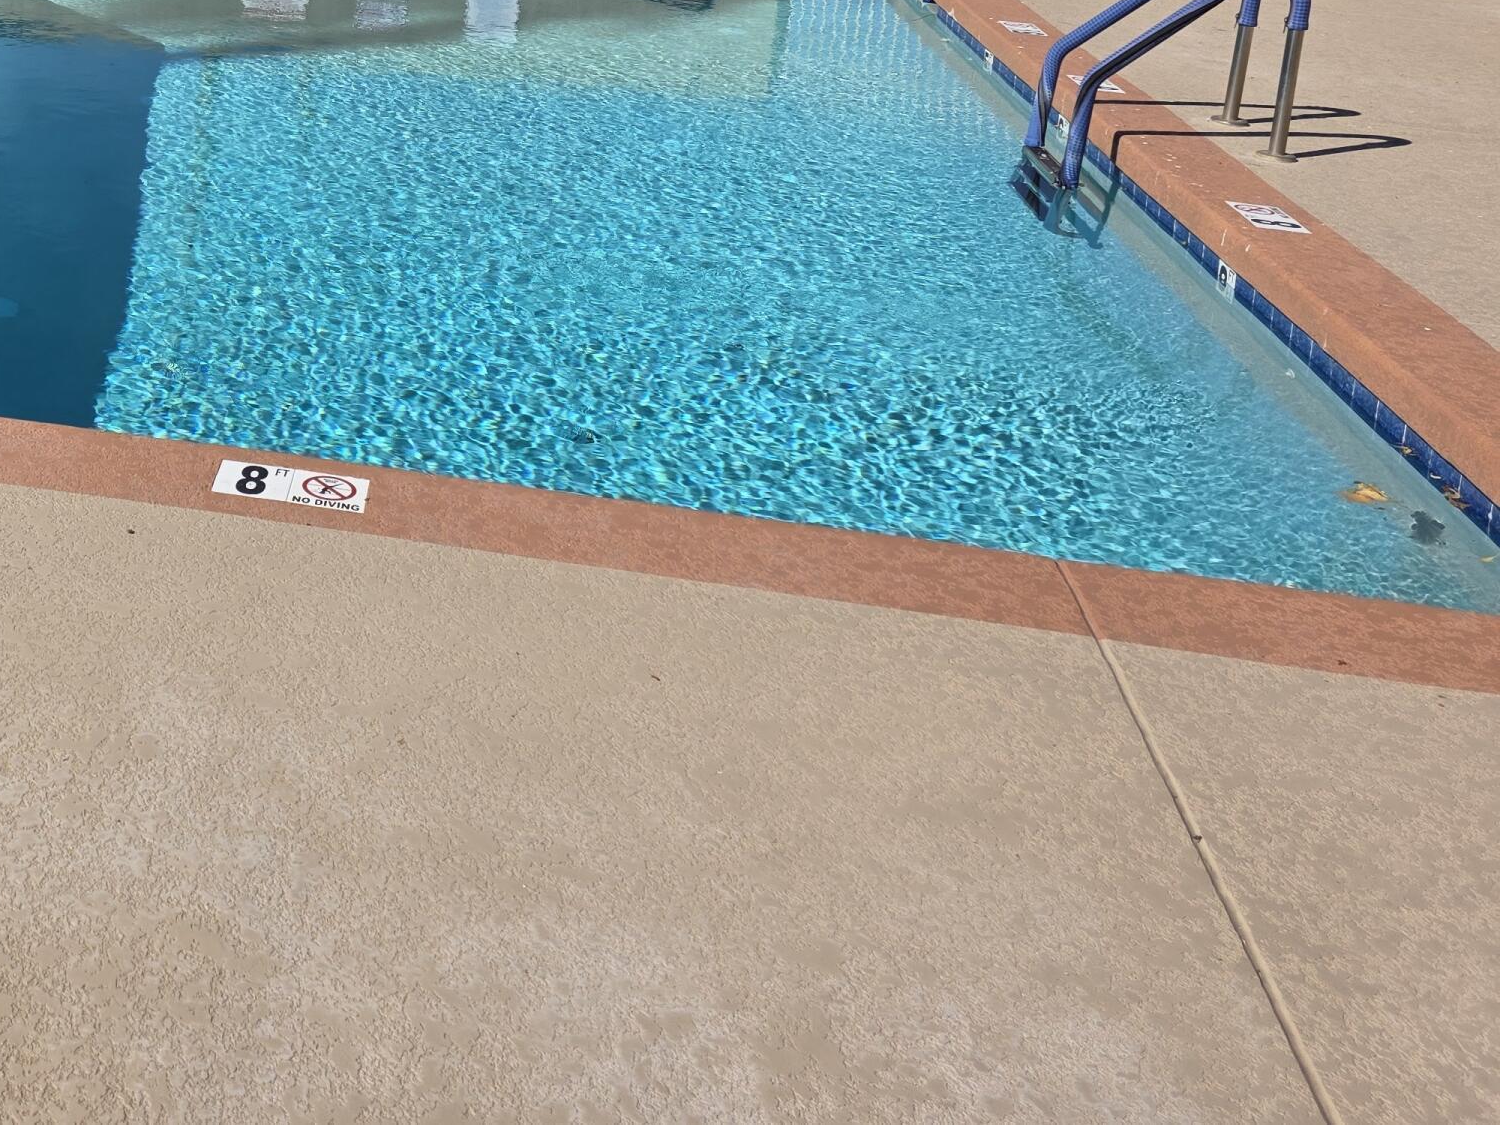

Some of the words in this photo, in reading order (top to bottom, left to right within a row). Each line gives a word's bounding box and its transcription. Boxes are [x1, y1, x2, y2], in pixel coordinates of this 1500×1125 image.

[1251, 218, 1302, 229] 8
[235, 465, 269, 495] 8
[275, 468, 290, 477] FT
[291, 495, 311, 505] NO
[314, 498, 360, 512] DIVING
